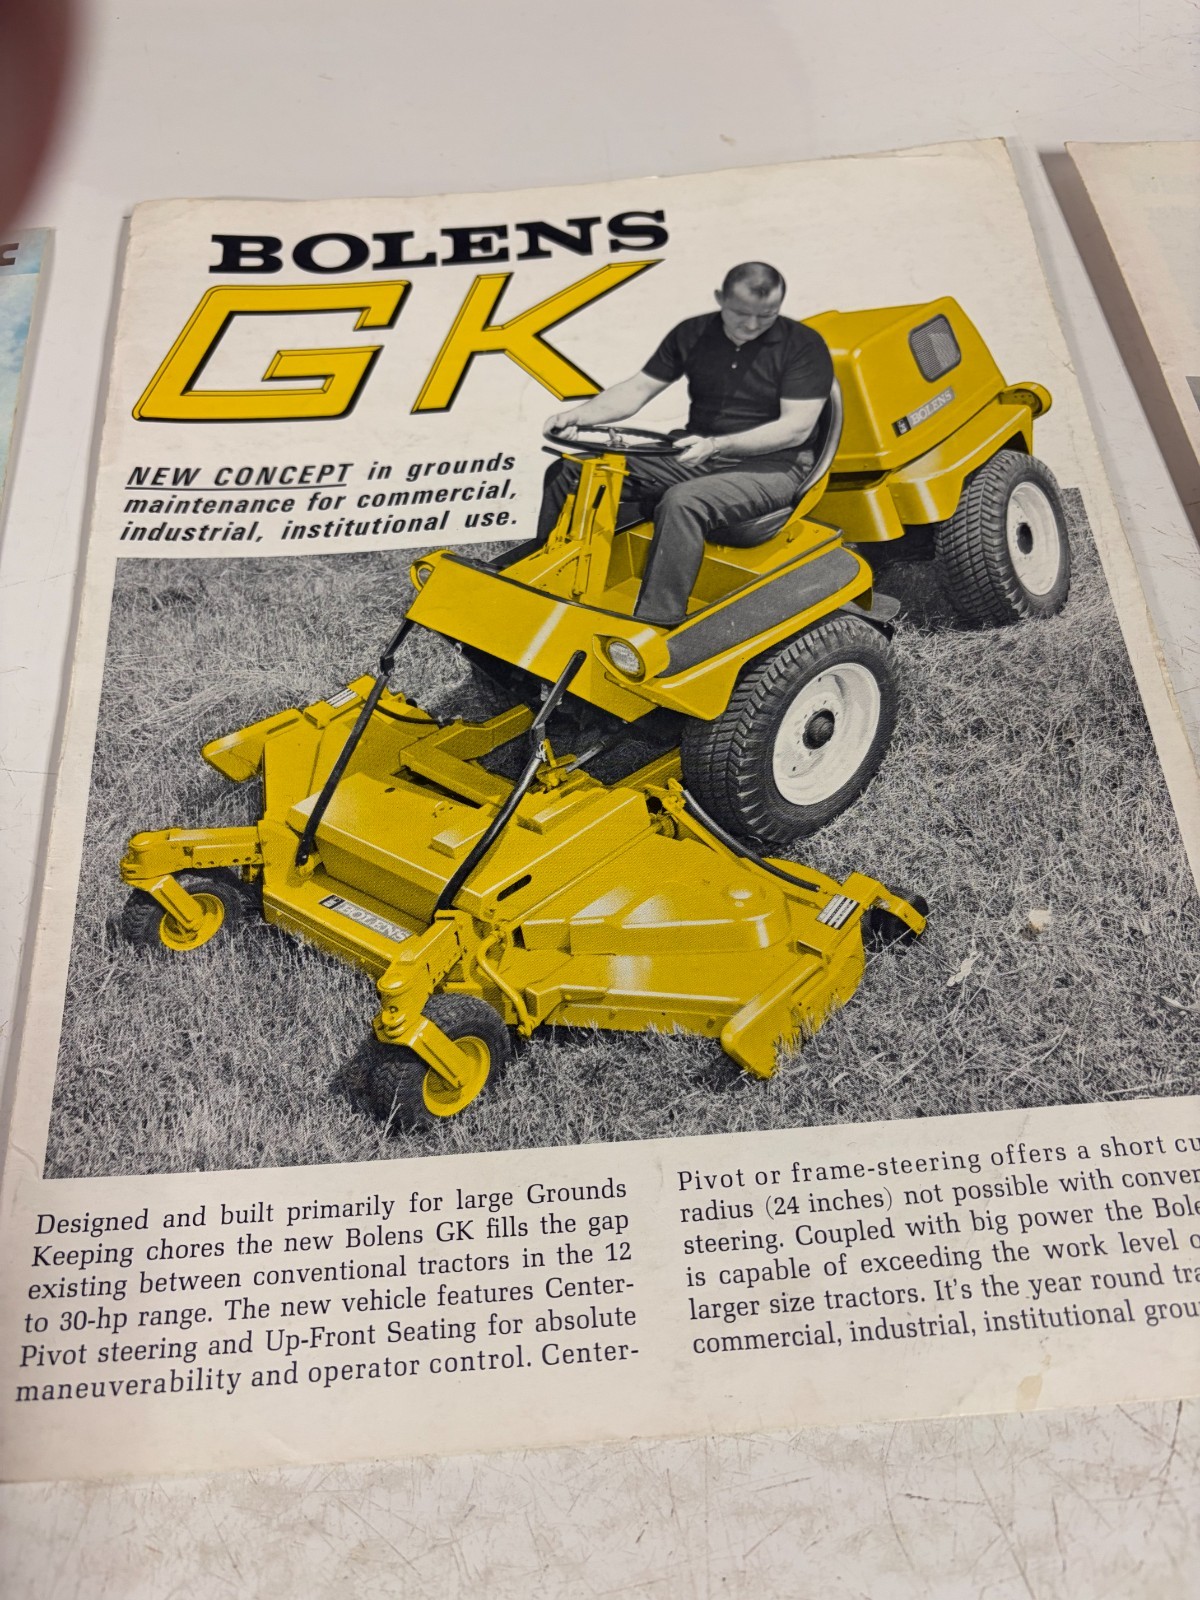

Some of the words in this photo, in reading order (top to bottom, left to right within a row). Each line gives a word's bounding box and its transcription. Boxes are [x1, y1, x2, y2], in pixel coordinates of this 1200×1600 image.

[209, 210, 669, 273] BOLENS
[132, 259, 665, 422] GK
[909, 389, 953, 425] BOLENS
[123, 495, 295, 514] maintenance
[307, 492, 346, 511] for
[357, 479, 516, 508] commercial,
[127, 466, 201, 486] NEW
[214, 463, 354, 486] CONCEPT
[367, 461, 392, 480] in
[406, 452, 515, 482] grounds
[120, 521, 263, 542] industrial,
[281, 510, 450, 540] institutional
[464, 511, 516, 528] use.
[677, 1169, 745, 1191] Pivot
[755, 1170, 781, 1185] or
[791, 1151, 981, 1183] frame-steering
[991, 1143, 1066, 1166] offers
[1077, 1145, 1091, 1159] a
[1100, 1136, 1166, 1158] short
[35, 1208, 148, 1237] Designed
[163, 1205, 206, 1228] and
[221, 1201, 273, 1225] built
[287, 1194, 395, 1226] primarily
[410, 1191, 443, 1213] for
[456, 1188, 513, 1212] large
[527, 1177, 626, 1204] Grounds
[680, 1199, 754, 1223] radius
[766, 1196, 799, 1219] (24
[809, 1187, 892, 1213] inches)
[904, 1184, 943, 1205] not
[952, 1174, 1048, 1206] possible
[1059, 1168, 1113, 1192] with
[31, 1243, 134, 1270] Keeping
[146, 1238, 224, 1260] chores
[237, 1233, 272, 1255] the
[284, 1235, 333, 1252] new
[346, 1225, 423, 1248] Bolens
[436, 1220, 474, 1242] GK
[487, 1216, 528, 1238] fills
[540, 1213, 576, 1234] the
[589, 1214, 629, 1237] gap
[684, 1230, 783, 1255] steering.
[795, 1217, 895, 1248] Coupled
[905, 1212, 961, 1236] with
[970, 1210, 1008, 1235] big
[1018, 1208, 1093, 1234] power
[1105, 1199, 1143, 1221] the
[28, 1276, 127, 1301] existing
[140, 1271, 241, 1293] between
[253, 1255, 406, 1286] conventional
[418, 1254, 509, 1275] tractors
[522, 1248, 545, 1268] in
[557, 1243, 593, 1265] the
[606, 1242, 631, 1261] 12
[686, 1267, 706, 1287] is
[719, 1257, 810, 1288] capable
[824, 1253, 847, 1276] of
[861, 1245, 982, 1273] exceeding
[992, 1240, 1030, 1263] the
[1043, 1234, 1108, 1259] work
[1118, 1228, 1179, 1254] level
[25, 1314, 48, 1333] to
[60, 1307, 127, 1334] 30-hp
[138, 1308, 212, 1330] range.
[224, 1297, 270, 1320] The
[281, 1299, 331, 1317] new
[342, 1286, 426, 1312] vehicle
[438, 1284, 533, 1306] features
[545, 1276, 634, 1298] Center-
[689, 1297, 760, 1323] larger
[770, 1292, 815, 1314] size
[824, 1287, 925, 1309] tractors.
[934, 1279, 972, 1301] It's
[981, 1274, 1019, 1298] the
[1028, 1276, 1081, 1300] year
[1091, 1263, 1164, 1290] round
[19, 1344, 87, 1367] Pivot
[98, 1338, 197, 1363] steering
[208, 1330, 253, 1355] and
[266, 1325, 375, 1356] Up-Front
[388, 1318, 476, 1343] Seating
[488, 1313, 523, 1336] for
[535, 1306, 636, 1332] absolute
[693, 1321, 842, 1354] commercial,
[850, 1311, 976, 1342] industrial,
[984, 1299, 1135, 1332] institutional
[15, 1367, 241, 1402] maneuverability
[251, 1361, 298, 1387] and
[308, 1357, 420, 1388] operator
[429, 1344, 531, 1374] control.
[542, 1343, 639, 1366] Center-
